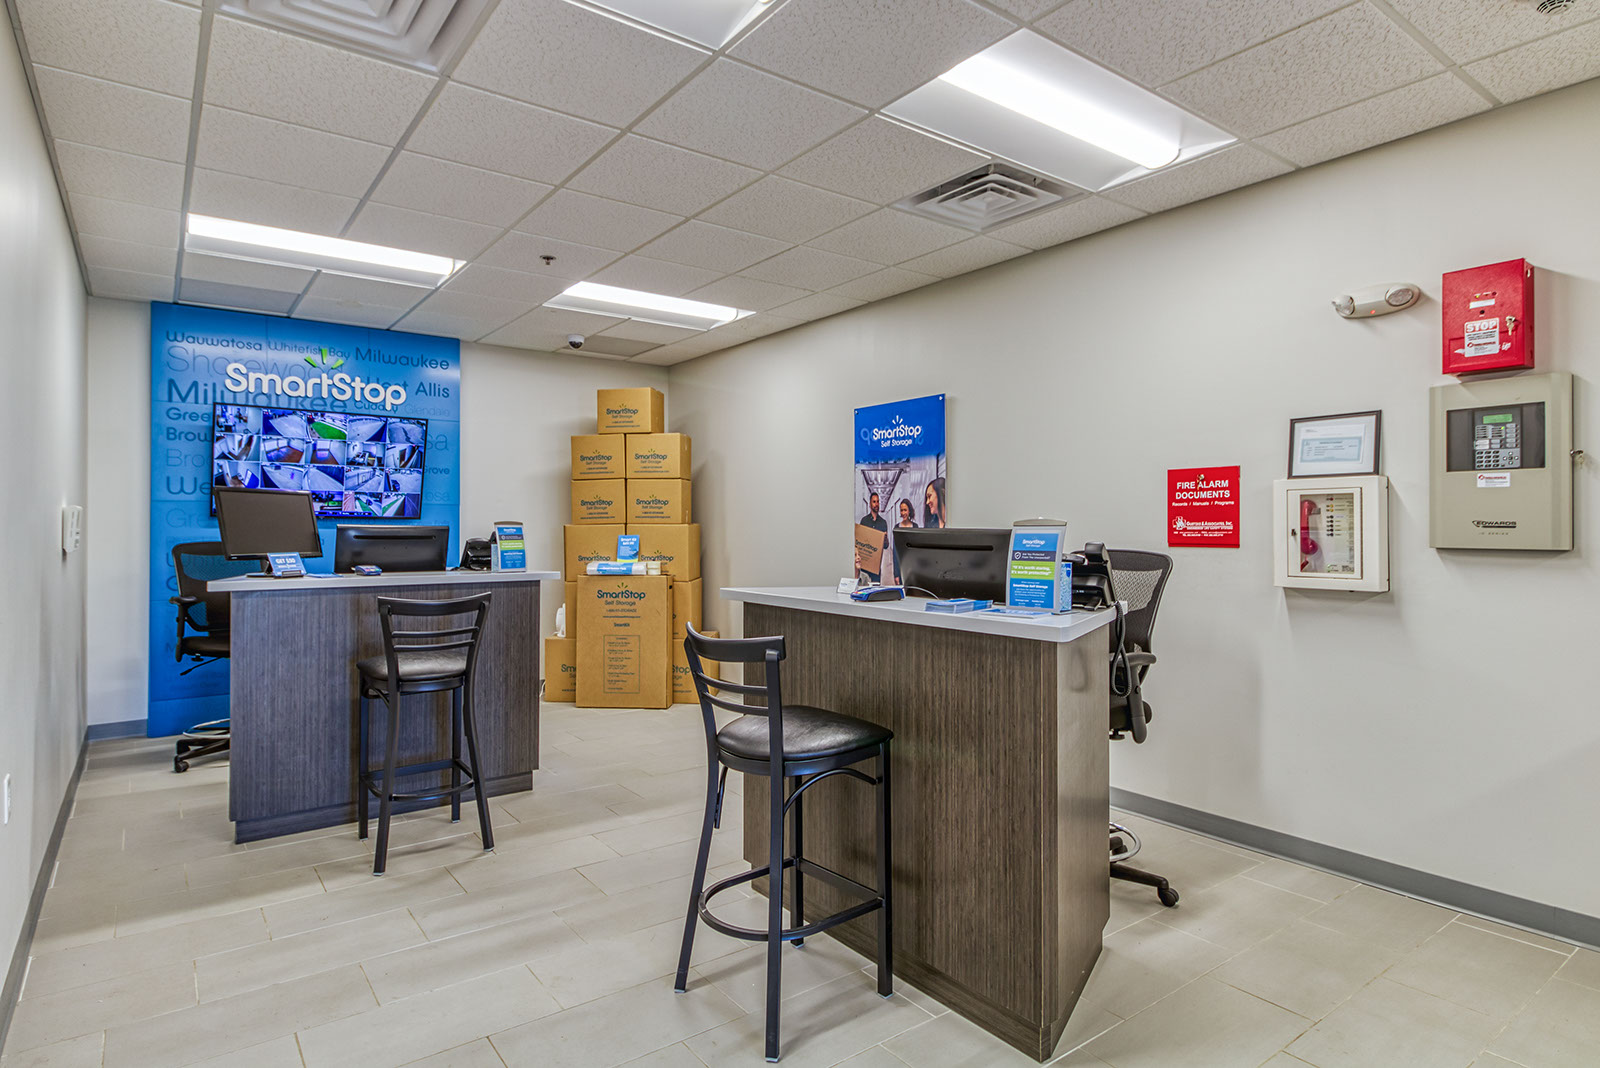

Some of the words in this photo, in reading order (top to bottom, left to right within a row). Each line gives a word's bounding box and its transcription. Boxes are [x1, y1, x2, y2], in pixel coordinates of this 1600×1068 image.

[1467, 320, 1497, 332] STOP
[166, 330, 262, 351] Wauwatosa
[268, 340, 323, 356] Whitefish
[328, 346, 350, 360] Bay
[356, 347, 450, 370] Milwaukee
[225, 363, 406, 411] SmartStop
[415, 381, 450, 398] Allis
[873, 424, 922, 440] SmartStop
[881, 440, 890, 448] Self
[891, 439, 912, 447] Storage
[1198, 480, 1229, 488] ALARM
[1176, 490, 1230, 499] DOCUMENTS
[597, 589, 646, 600] SmartStop
